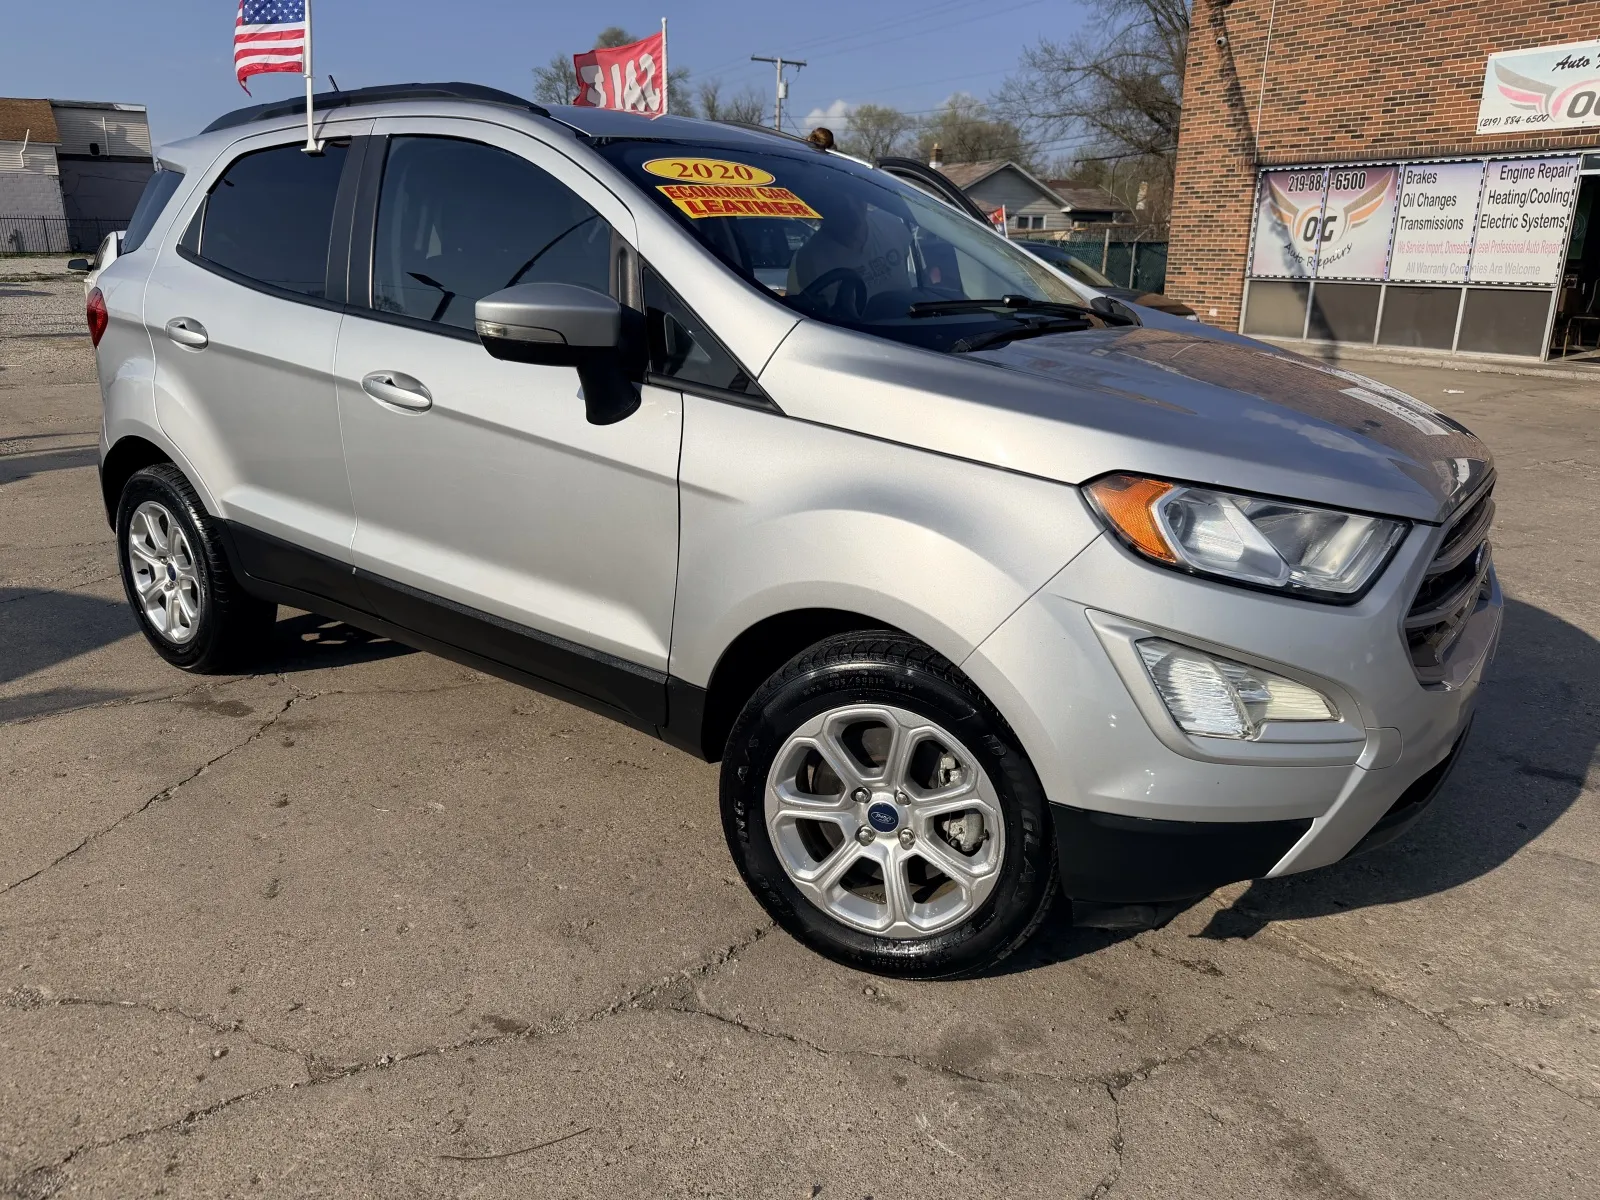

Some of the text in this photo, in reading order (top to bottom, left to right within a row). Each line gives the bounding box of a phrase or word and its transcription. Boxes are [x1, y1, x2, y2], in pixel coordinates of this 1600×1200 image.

[1552, 54, 1590, 72] Auto
[1566, 91, 1600, 118] O
[1479, 114, 1549, 127] (219) 884-6500
[671, 162, 754, 181] 2020
[1406, 169, 1437, 185] Brakes
[1500, 162, 1573, 184] Engine Repair
[1288, 171, 1366, 192] 219-88-6500
[663, 185, 797, 201] ECONOMY CAR
[1403, 192, 1457, 211] Oil Changes
[1488, 188, 1570, 209] Heating/Cooling
[684, 200, 815, 216] LEATHER
[1303, 216, 1337, 241] OG
[1400, 216, 1464, 231] Transmissions
[1480, 212, 1565, 232] Electric Systems
[1284, 242, 1304, 264] Auto
[1406, 240, 1424, 254] Service
[1491, 240, 1525, 254] Professional
[1526, 240, 1539, 254] Auto
[1406, 262, 1541, 276] All Warranty Comnies Are Welcome
